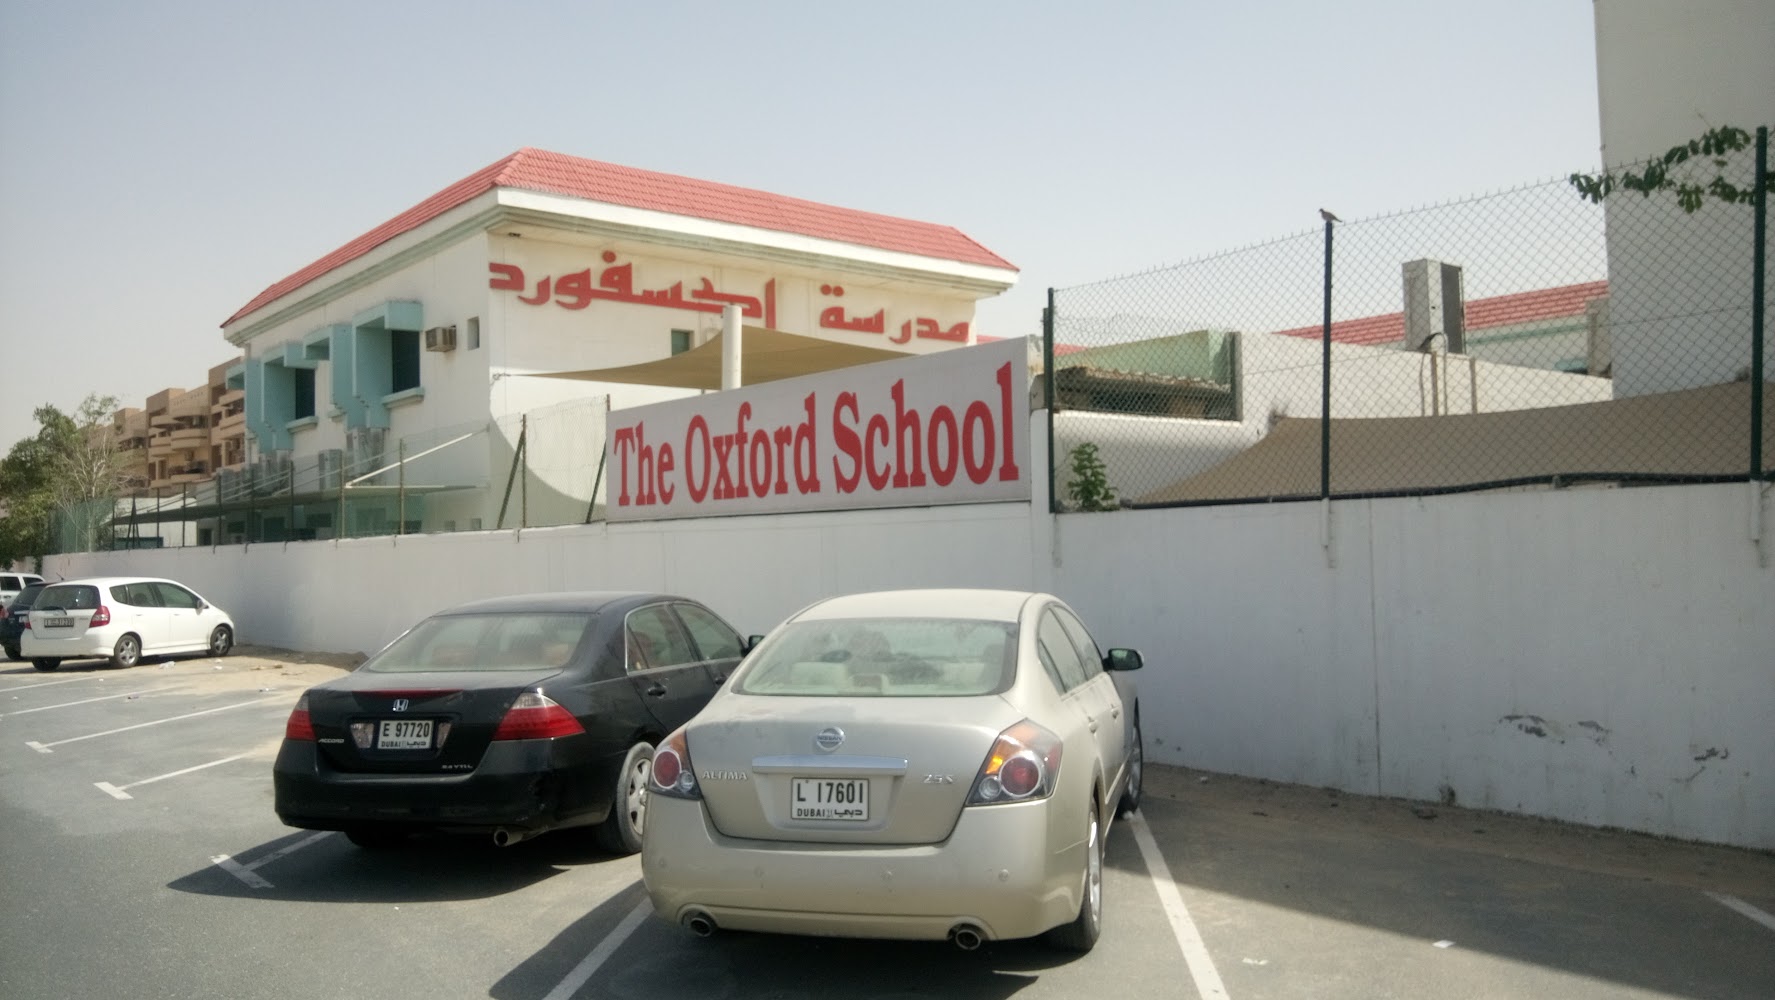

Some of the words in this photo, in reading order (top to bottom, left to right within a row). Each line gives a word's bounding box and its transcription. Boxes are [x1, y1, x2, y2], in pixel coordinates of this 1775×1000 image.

[820, 283, 970, 344] مدرسة
[614, 421, 675, 506] The
[685, 391, 820, 503] Oxford
[832, 361, 1019, 494] School
[383, 723, 390, 736] E
[395, 722, 430, 737] 97720
[702, 770, 748, 780] ALTIMA
[797, 783, 806, 802] L
[817, 782, 863, 803] 17601
[797, 808, 825, 817] DUBAI
[834, 809, 863, 818] دبي
